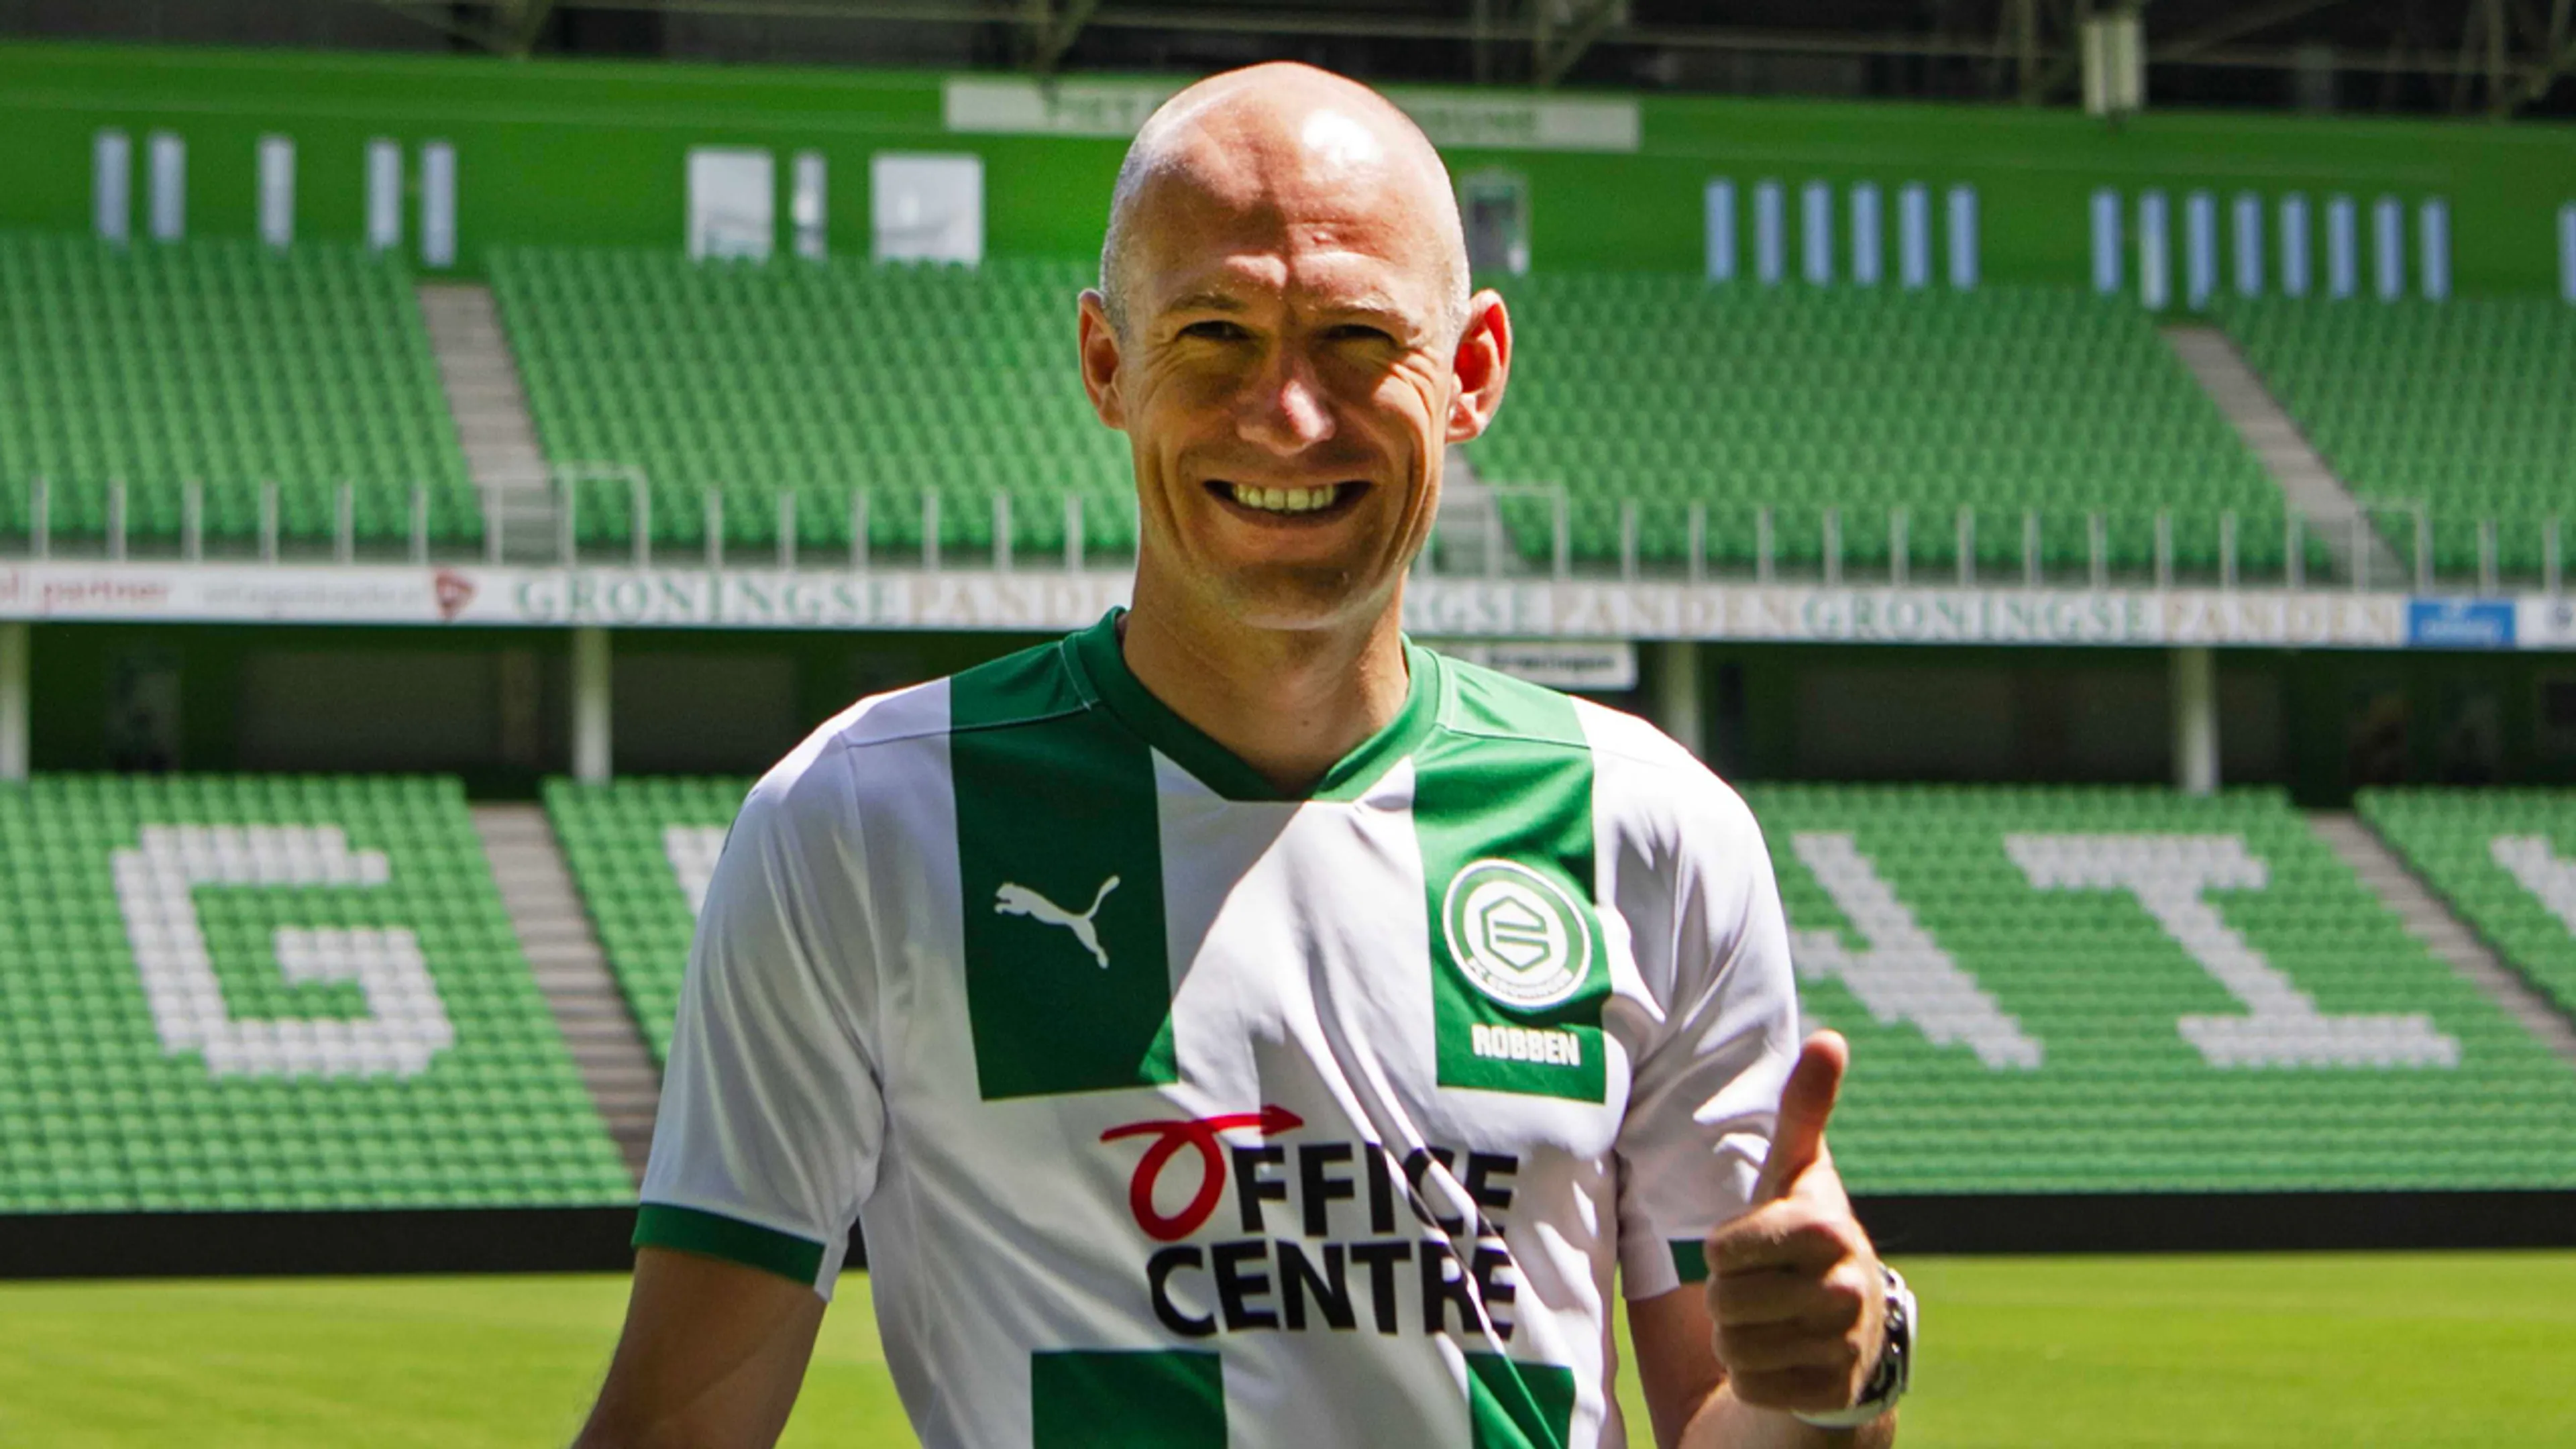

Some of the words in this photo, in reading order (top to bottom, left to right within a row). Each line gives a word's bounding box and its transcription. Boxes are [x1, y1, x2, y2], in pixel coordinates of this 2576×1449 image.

[516, 573, 902, 624] GRONINGSE
[1801, 589, 2159, 639] GRONINGSE
[1471, 1023, 1581, 1067] ROBBEN
[1127, 1120, 1519, 1243] OFFICE
[1146, 1238, 1518, 1341] CENTRE
